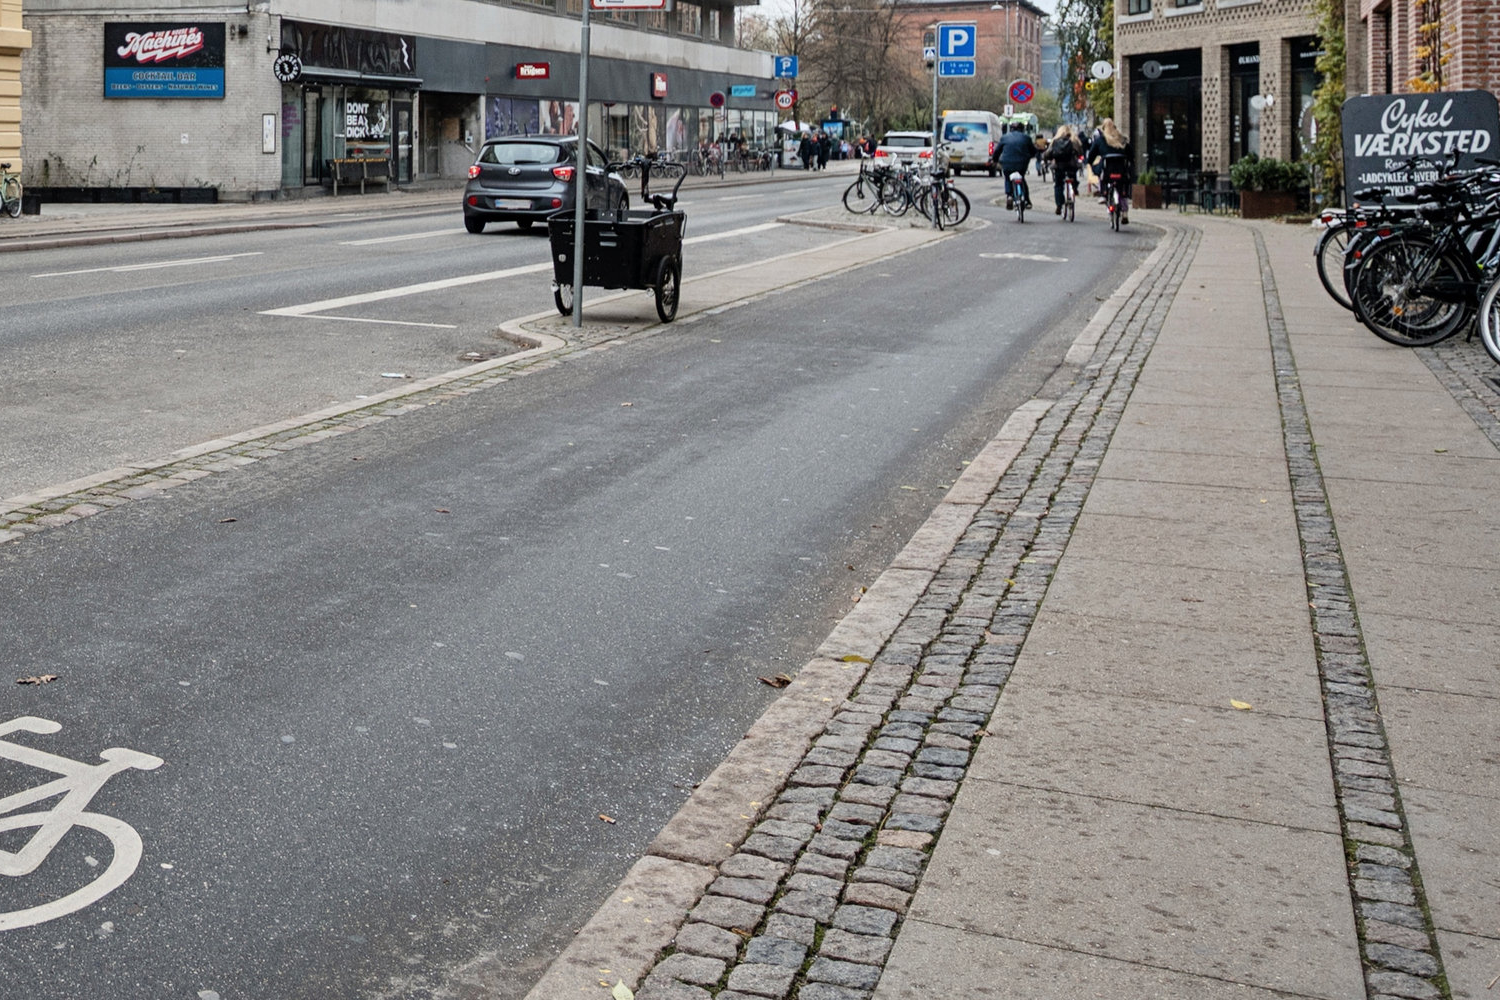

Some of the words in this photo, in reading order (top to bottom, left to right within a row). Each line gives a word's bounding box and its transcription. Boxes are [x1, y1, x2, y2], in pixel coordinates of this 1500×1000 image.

[117, 30, 204, 63] Machines
[948, 29, 969, 55] P
[782, 61, 791, 70] P
[132, 71, 176, 81] COCKTAIL
[176, 71, 196, 81] BAR
[779, 96, 791, 104] 40
[346, 102, 369, 114] DONT
[346, 114, 357, 125] BE
[1381, 98, 1453, 137] Cykel
[346, 126, 366, 138] DICK
[1354, 129, 1491, 157] VÆRKSTED
